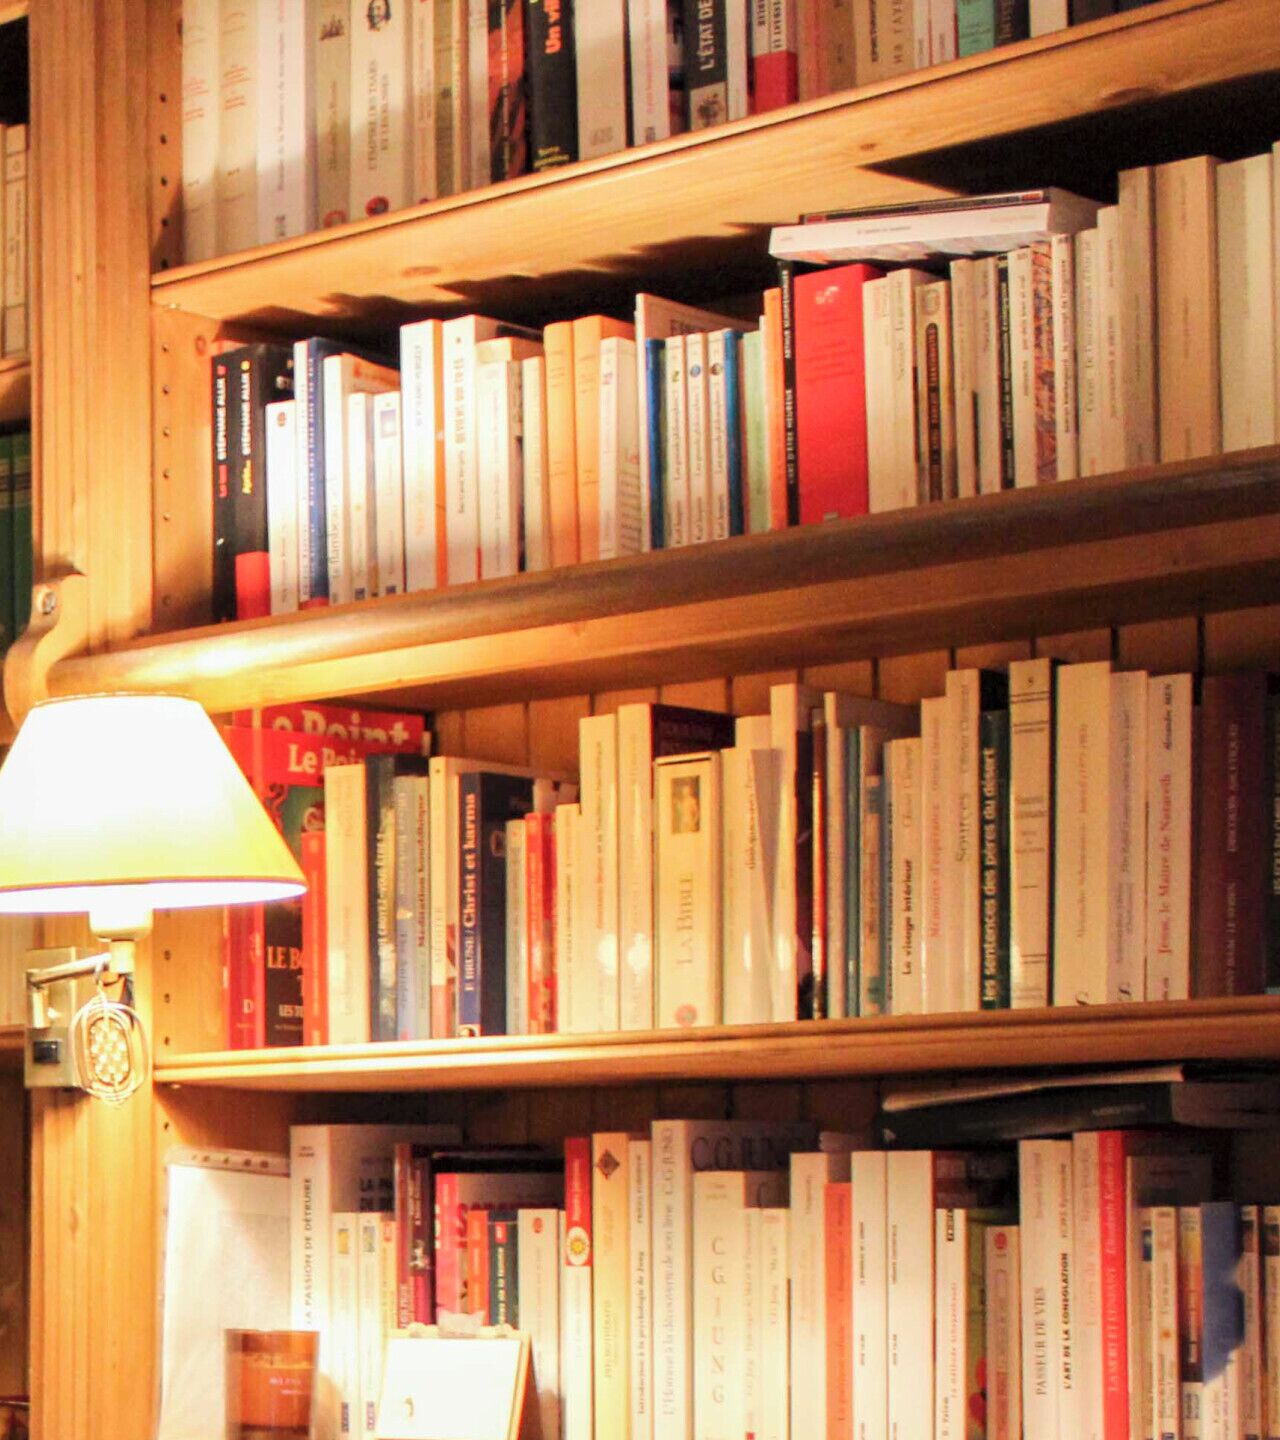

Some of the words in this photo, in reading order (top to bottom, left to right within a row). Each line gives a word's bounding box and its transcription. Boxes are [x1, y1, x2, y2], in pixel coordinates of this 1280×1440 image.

[545, 26, 562, 55] Un
[695, 23, 716, 71] L'ÉTAT
[215, 378, 227, 406] ALLIX
[240, 372, 251, 400] ALLIX
[301, 708, 410, 746] Point
[287, 742, 319, 775] Le
[980, 747, 996, 798] désert
[981, 801, 996, 820] du
[1158, 773, 1172, 832] Nazareth
[461, 791, 477, 849] karma
[954, 791, 972, 863] Sources
[982, 823, 998, 866] pères
[1158, 834, 1172, 853] de
[462, 851, 477, 869] et
[902, 858, 913, 913] intérieur
[982, 869, 997, 896] des
[462, 873, 477, 928] Christ
[675, 870, 694, 933] BIBLE
[676, 935, 694, 966] LA
[903, 920, 915, 957] visage
[982, 898, 997, 977] sentences
[267, 946, 288, 969] LE
[902, 960, 913, 976] Le
[981, 978, 997, 1001] les
[661, 1127, 676, 1166] JUNG
[301, 1178, 313, 1232] DÉTRUIRE
[302, 1235, 313, 1251] DE
[663, 1230, 674, 1250] son
[636, 1251, 648, 1274] Jung
[662, 1252, 674, 1267] de
[302, 1253, 313, 1307] PASSION
[636, 1274, 646, 1286] de
[1059, 1252, 1072, 1325] CONSOLATION
[636, 1287, 648, 1339] psychologie
[662, 1267, 675, 1330] découverte
[1032, 1287, 1046, 1316] VIES
[662, 1332, 675, 1346] la
[1033, 1319, 1047, 1337] DE
[1061, 1328, 1072, 1342] LA
[636, 1339, 646, 1350] la
[1061, 1344, 1072, 1358] DE
[1033, 1339, 1048, 1396] PASSEUR
[1061, 1361, 1073, 1391] L'ART
[1106, 1346, 1120, 1376] MORT
